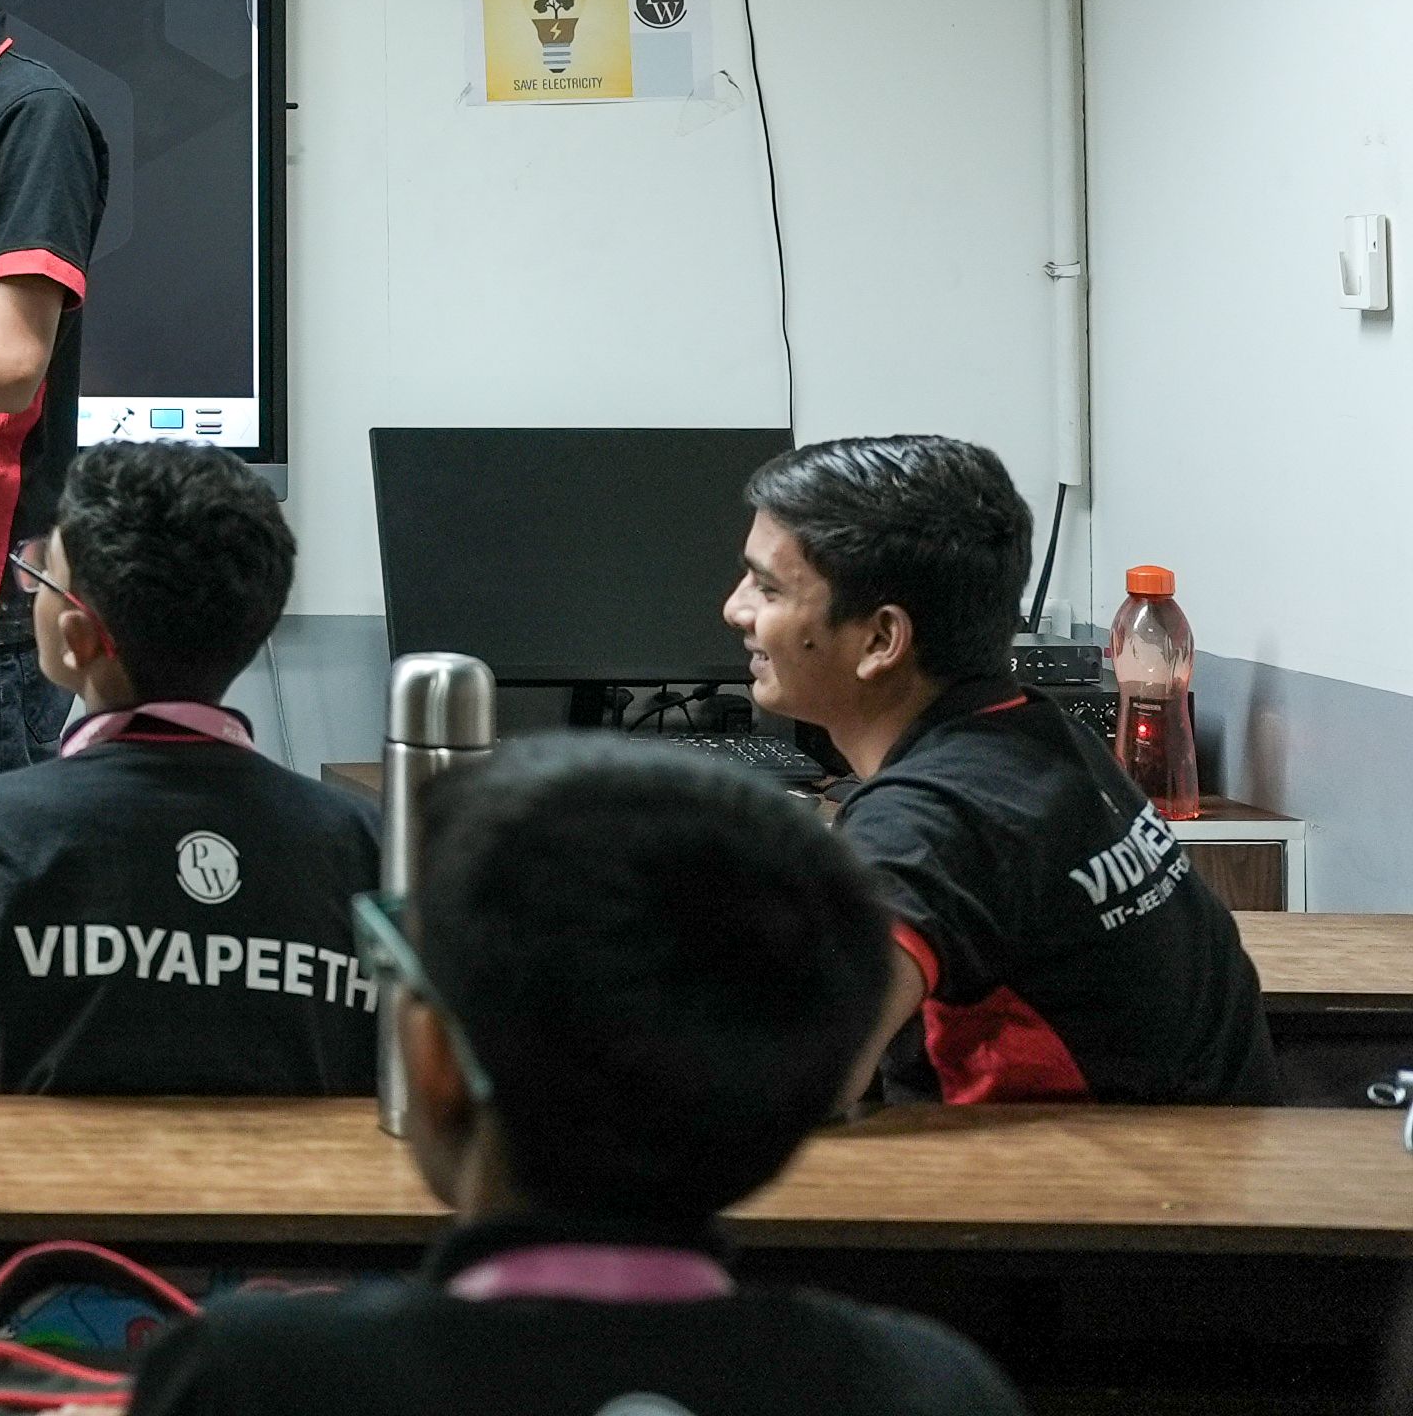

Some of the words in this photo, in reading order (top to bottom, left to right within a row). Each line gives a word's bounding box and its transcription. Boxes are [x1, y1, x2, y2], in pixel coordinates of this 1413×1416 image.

[513, 79, 537, 91] SAVE
[542, 77, 603, 90] ELECTRICITY
[14, 924, 378, 1012] VIDYAPEETH
